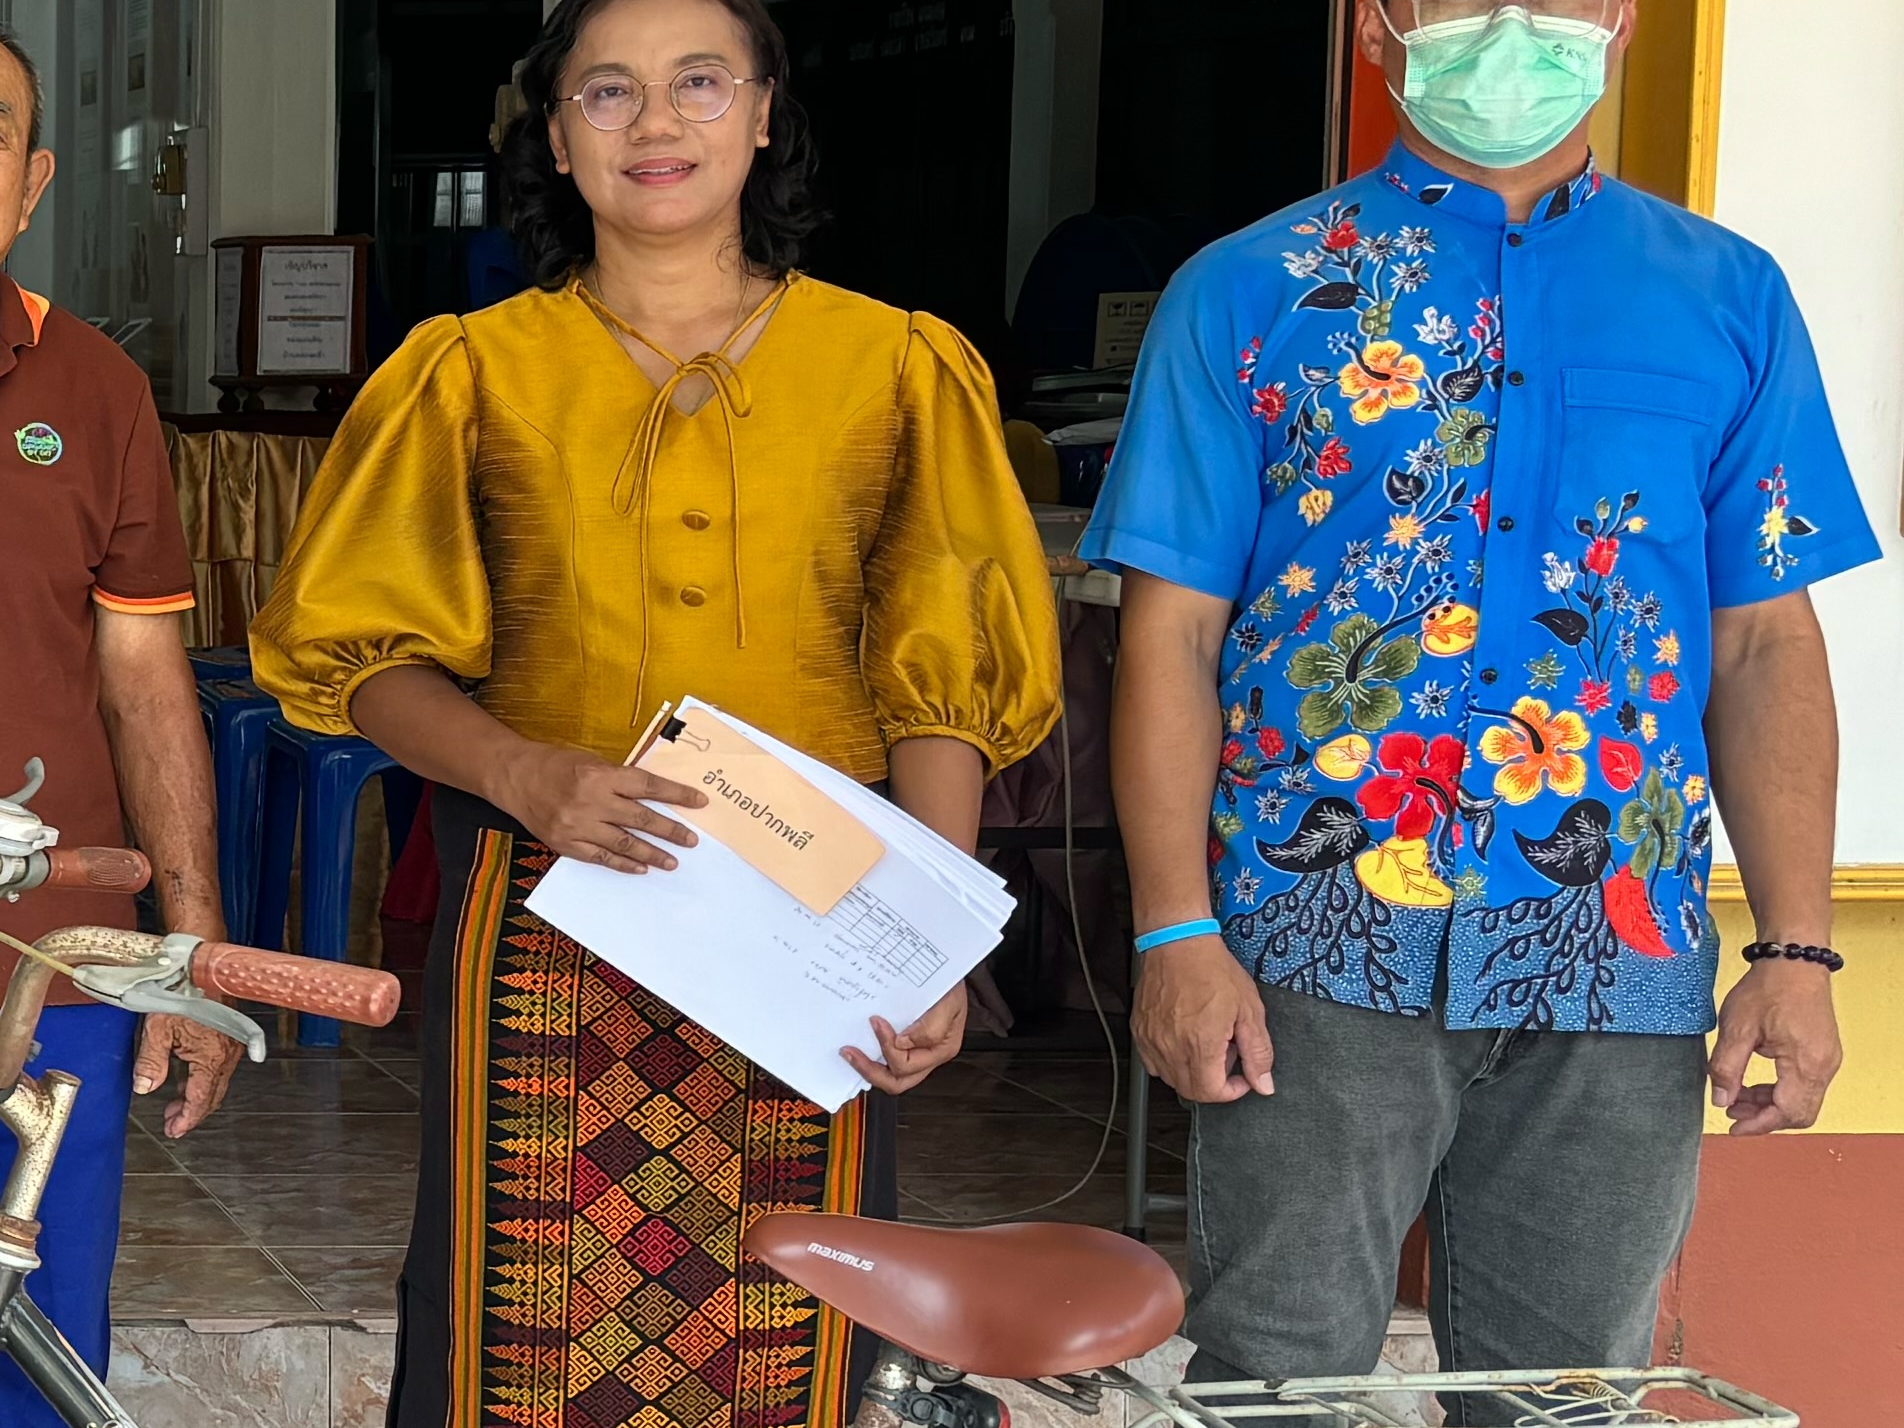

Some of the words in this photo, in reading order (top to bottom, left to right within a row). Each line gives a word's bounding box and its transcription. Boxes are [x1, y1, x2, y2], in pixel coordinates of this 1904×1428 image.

[702, 767, 816, 853] อำเภอปากพลี
